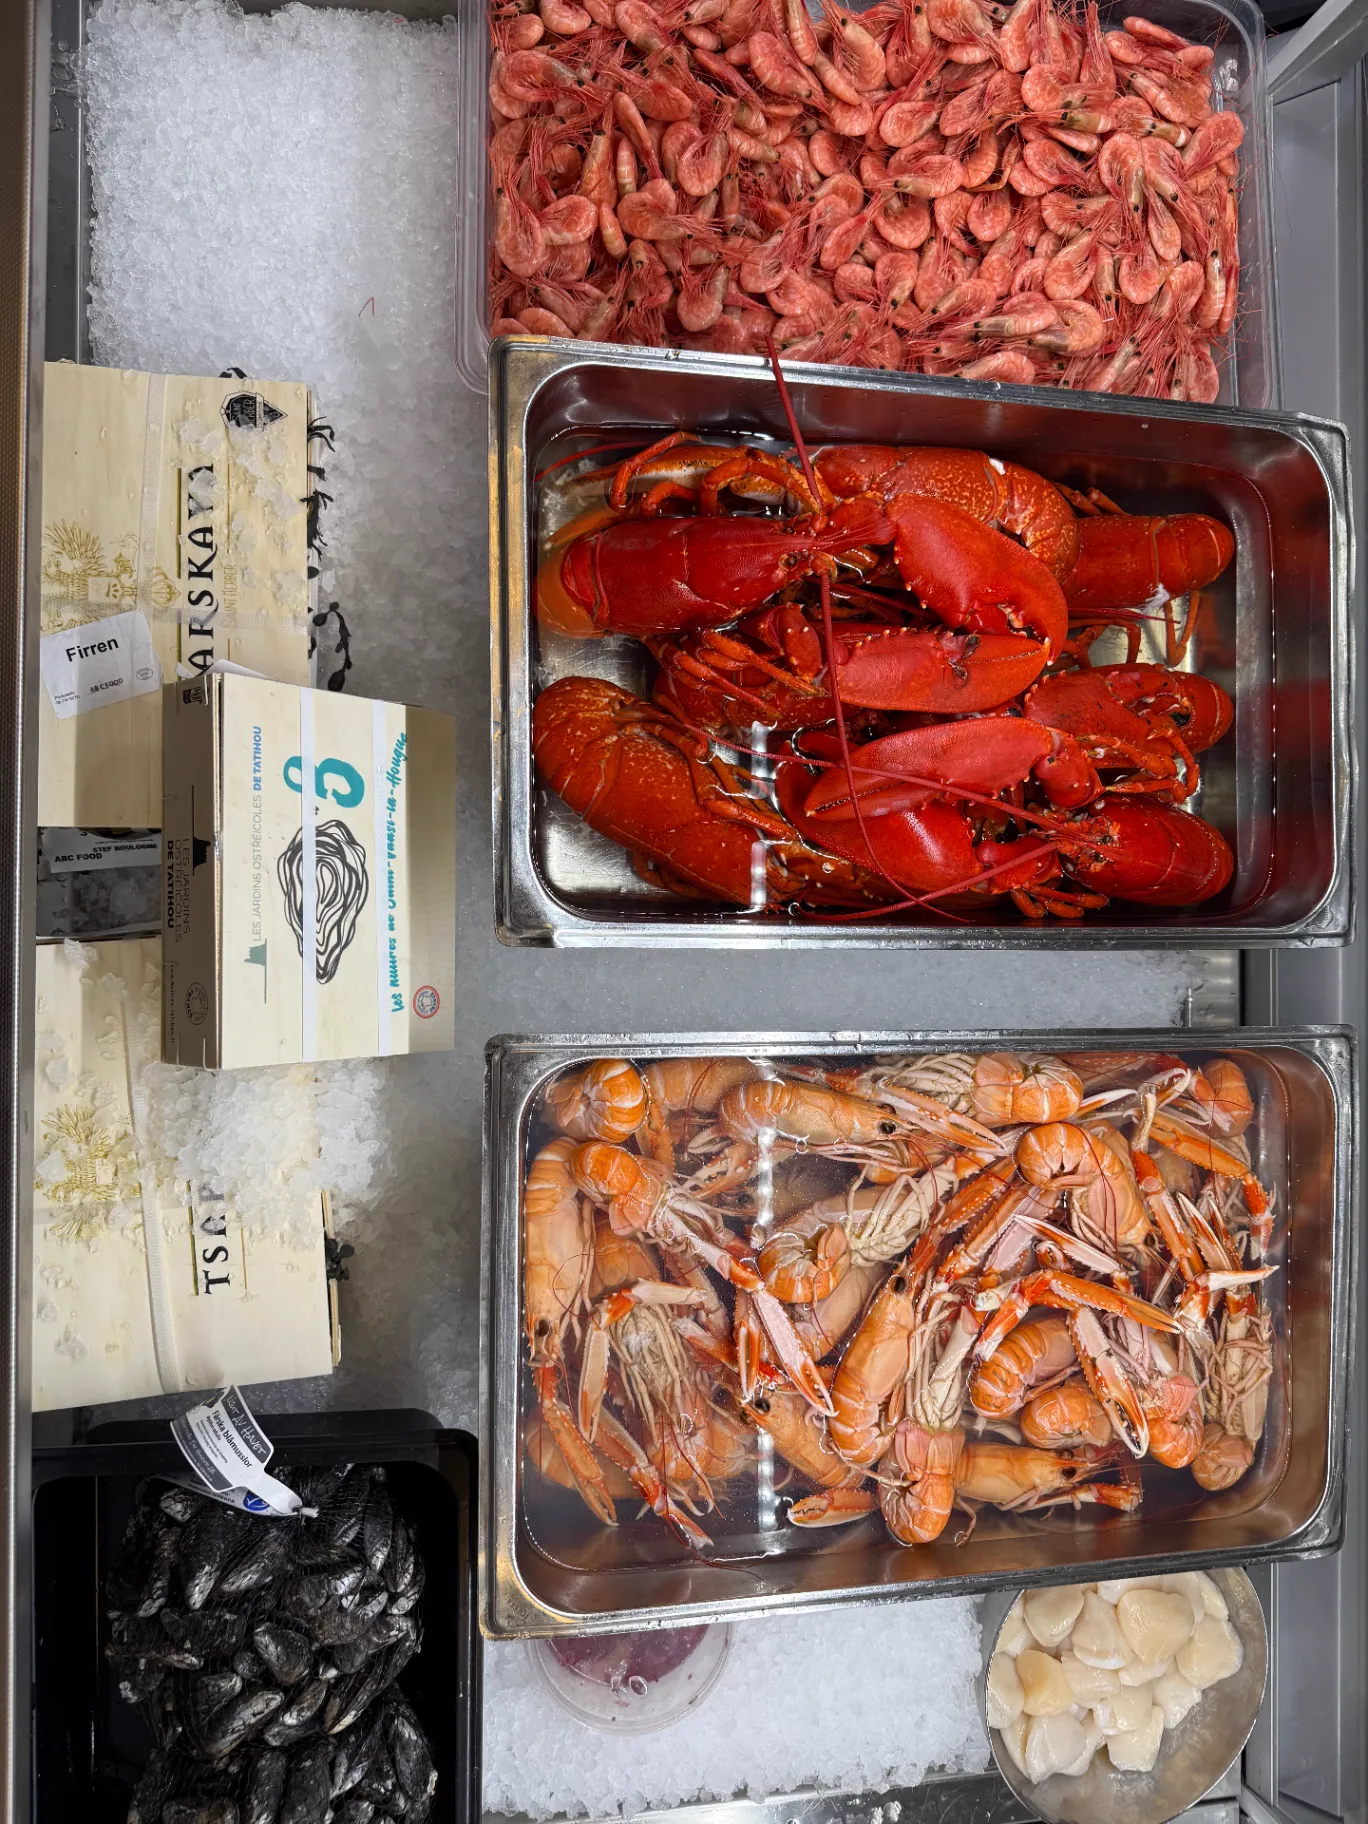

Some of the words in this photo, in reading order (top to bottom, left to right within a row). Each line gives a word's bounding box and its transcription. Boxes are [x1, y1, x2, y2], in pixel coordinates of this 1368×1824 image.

[65, 637, 119, 663] Firren
[252, 725, 262, 774] TATIHOU
[252, 775, 262, 792] DE
[92, 845, 113, 854] STEF
[114, 842, 159, 853] BOULOGNE
[167, 840, 175, 861] DE
[250, 794, 262, 870] OSTRÉICOLES
[54, 854, 75, 863] ABC
[76, 852, 103, 861] FOOD
[167, 862, 175, 929] TATIHOU
[174, 838, 183, 943] OSTRÉICOLES
[182, 868, 191, 935] JARDINS
[252, 872, 262, 921] JARDINS
[252, 922, 262, 942] LES
[211, 1410, 225, 1434] Färska
[222, 1430, 253, 1469] blåmusslor
[241, 1426, 267, 1457] HAVET
